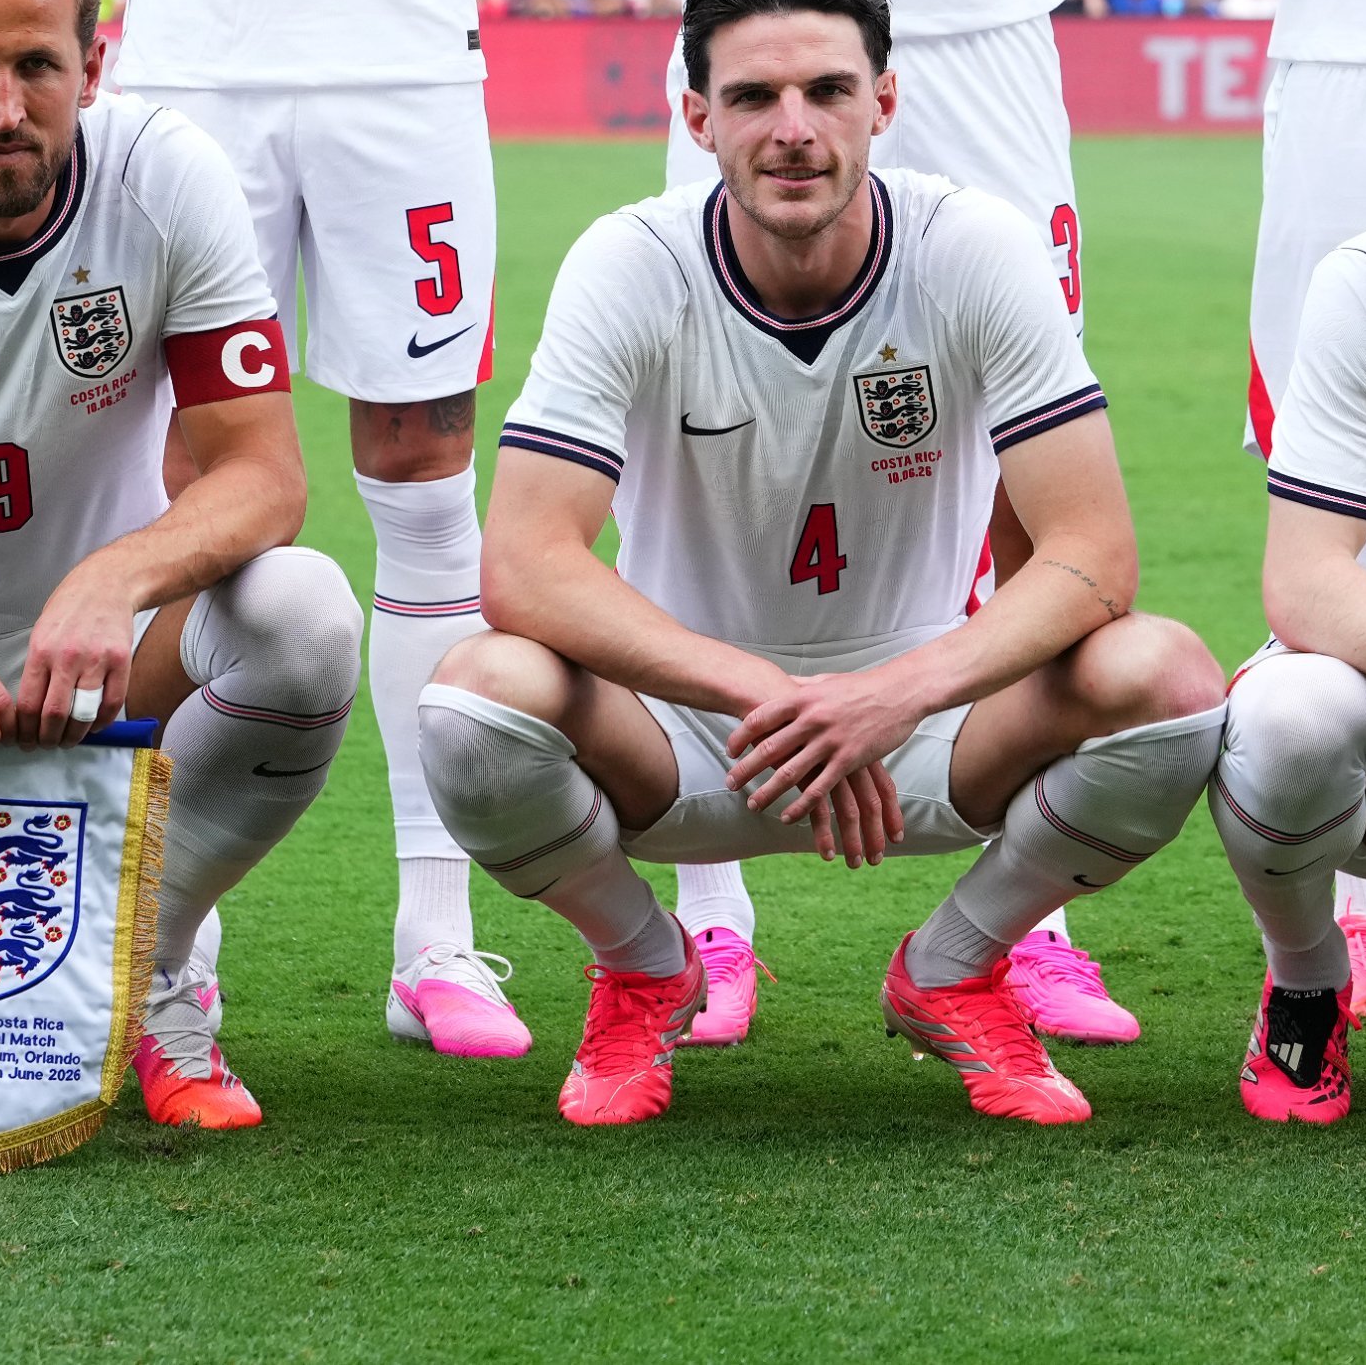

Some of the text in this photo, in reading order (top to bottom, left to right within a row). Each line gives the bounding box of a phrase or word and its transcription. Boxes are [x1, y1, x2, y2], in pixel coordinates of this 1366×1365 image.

[405, 201, 464, 317] 5
[1050, 203, 1080, 315] 3
[221, 330, 276, 388] C
[71, 368, 138, 406] COSTA RICA
[86, 388, 127, 415] 10.06.26
[871, 449, 942, 472] COSTA RICA
[887, 465, 933, 485] 10.06.26
[789, 503, 847, 596] 4
[33, 1017, 65, 1031] Rica
[10, 1032, 56, 1048] Match
[24, 1050, 81, 1066] Orlando
[8, 1066, 44, 1081] June
[47, 1068, 81, 1082] 2026
